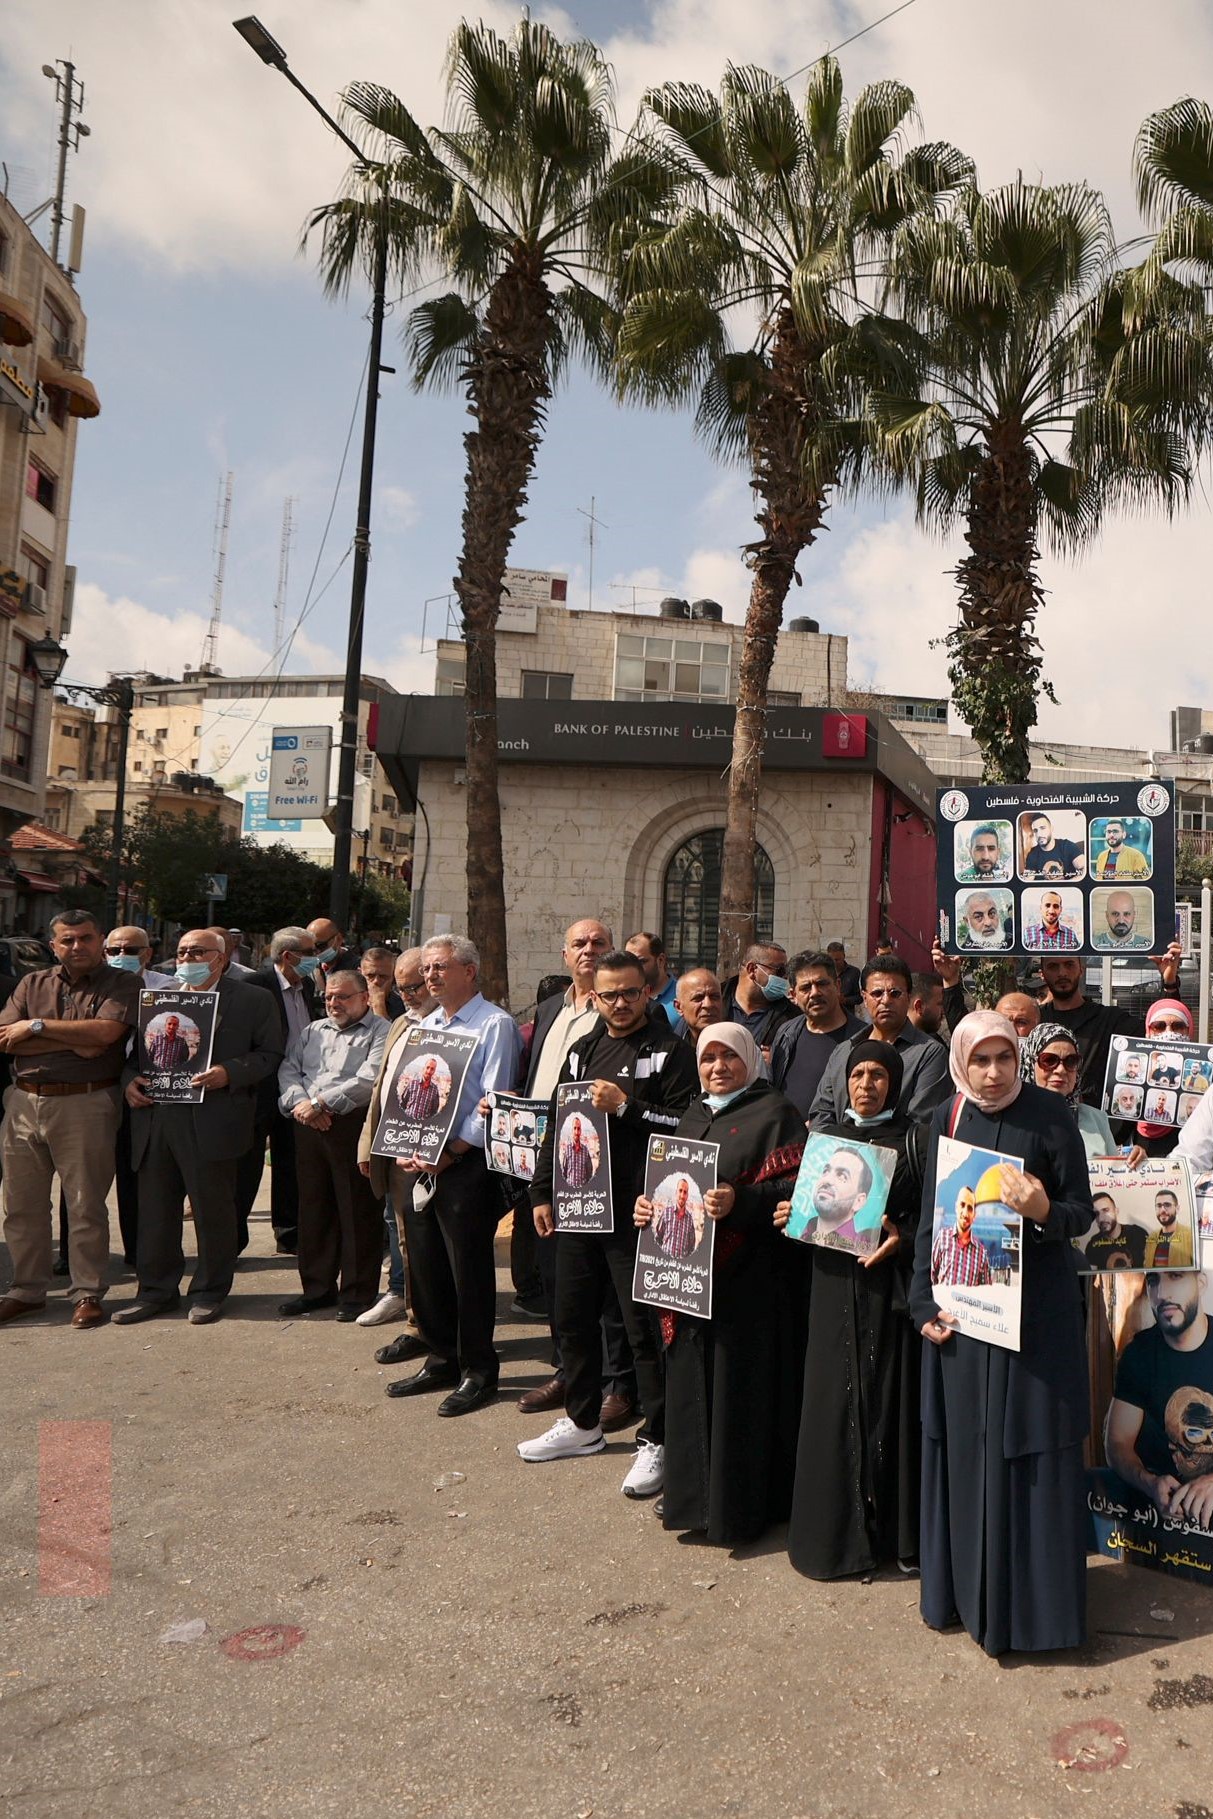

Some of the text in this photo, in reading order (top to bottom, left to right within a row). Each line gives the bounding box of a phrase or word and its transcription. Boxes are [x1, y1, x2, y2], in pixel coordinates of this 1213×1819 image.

[553, 722, 680, 738] BANK OF PALESTINE
[275, 796, 319, 805] Free Wi-Fi
[986, 797, 1019, 808] فلسطين
[1026, 795, 1064, 807] الفتحاوية
[1066, 794, 1096, 806] الشبيبة
[1096, 795, 1120, 806] حركة
[154, 993, 180, 1006] الفلسطيني
[200, 996, 213, 1007] نادي
[420, 1032, 444, 1046] الفلسطيني
[459, 1040, 473, 1051] نادي
[420, 1131, 440, 1147] علاء
[665, 1145, 690, 1162] الفلسطيني
[703, 1151, 716, 1169] نادي
[1126, 1181, 1138, 1189] حتى
[1139, 1180, 1158, 1189] مستمر
[583, 1198, 605, 1216] علاء
[681, 1275, 703, 1294] علاء
[956, 1296, 982, 1309] المهندس
[970, 1316, 991, 1328] سميح
[993, 1322, 1010, 1334] علاء
[1087, 1491, 1128, 1518] جوان)
[1106, 1531, 1157, 1553] السجان
[1161, 1549, 1212, 1573] ستقهر
